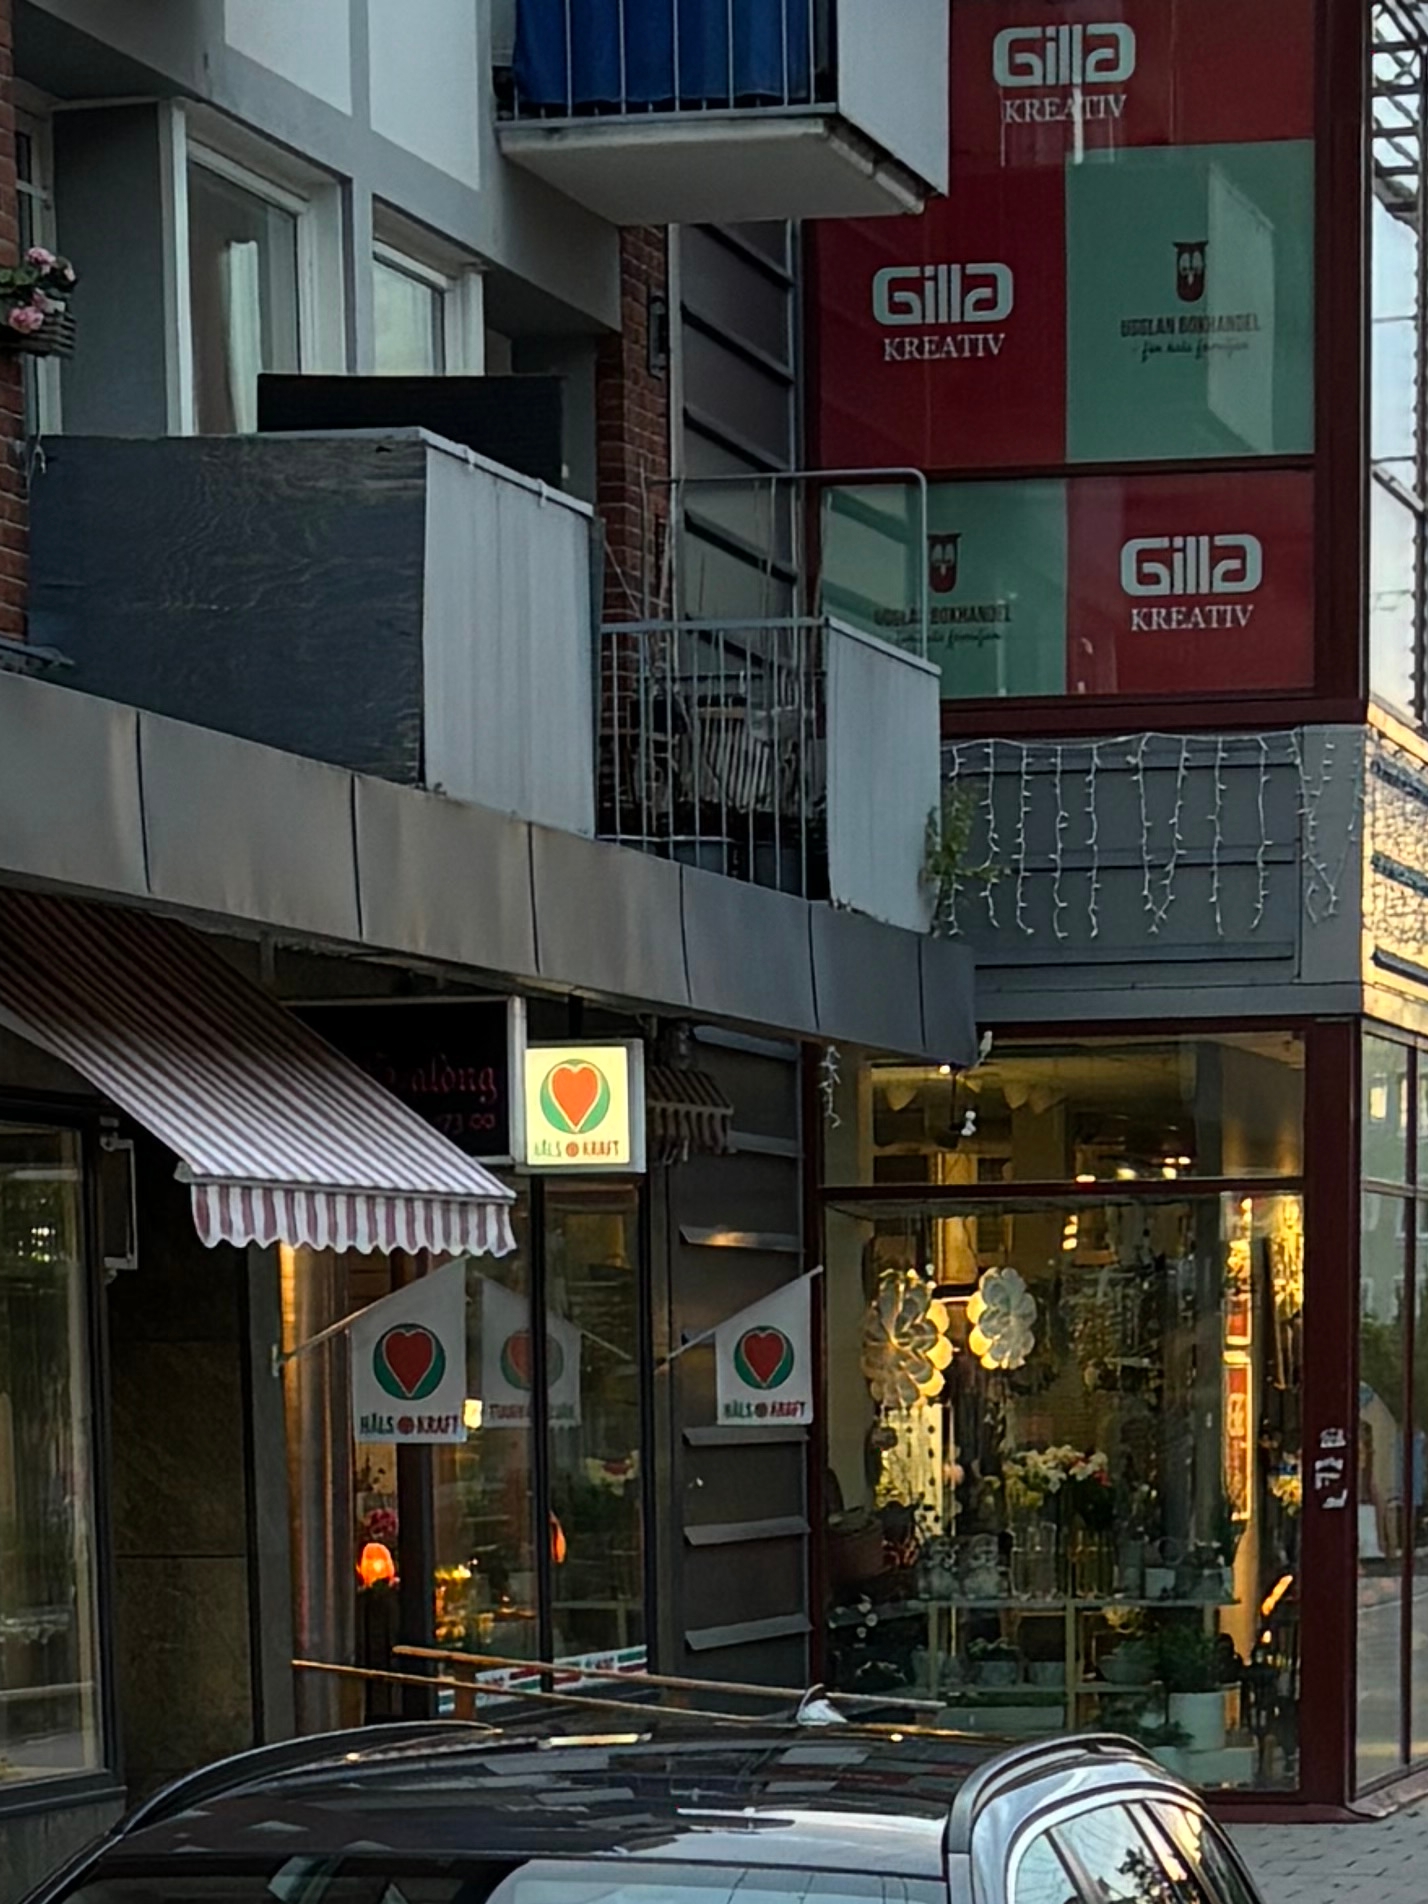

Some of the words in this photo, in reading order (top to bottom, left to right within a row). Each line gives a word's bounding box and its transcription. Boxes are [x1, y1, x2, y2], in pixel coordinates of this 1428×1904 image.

[993, 22, 1136, 87] Gilla
[1004, 94, 1127, 123] KREATIV
[873, 262, 1014, 326] Gilla
[883, 332, 1006, 361] KREATIV
[1120, 533, 1263, 597] Gilla
[1130, 603, 1255, 632] KREATIV
